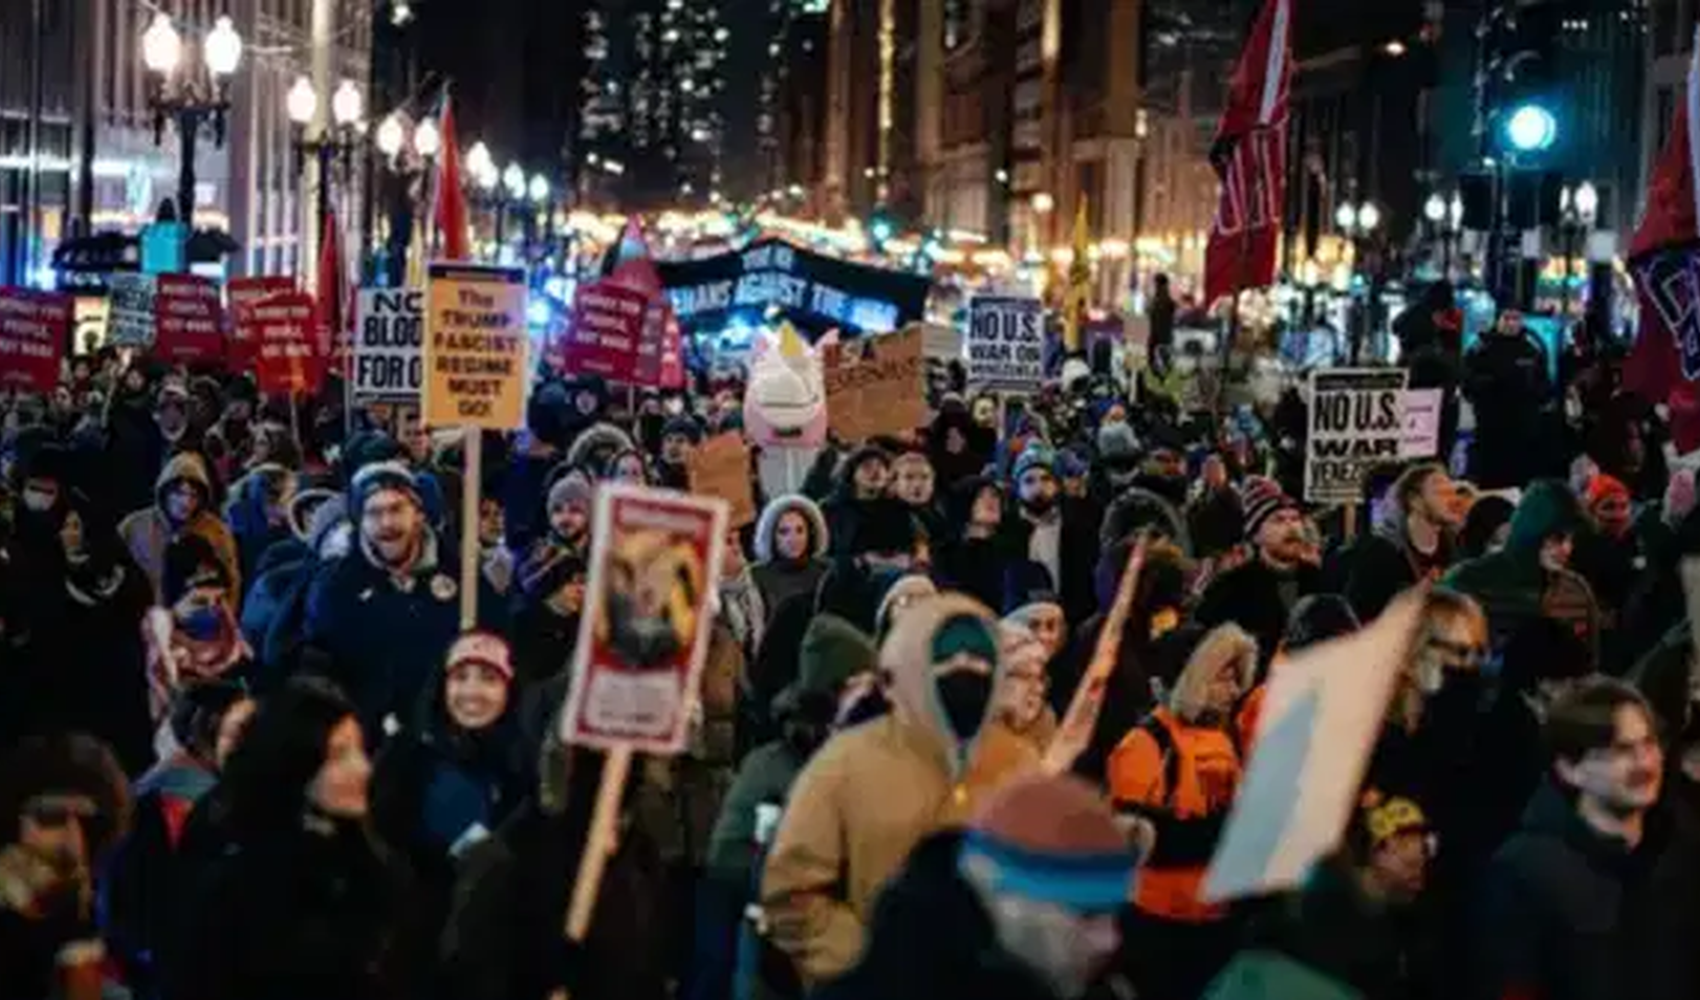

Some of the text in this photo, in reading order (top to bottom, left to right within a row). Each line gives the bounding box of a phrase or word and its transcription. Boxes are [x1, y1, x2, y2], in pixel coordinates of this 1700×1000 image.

[442, 308, 511, 329] TRUMP
[970, 310, 1041, 342] NO U.S.
[364, 316, 423, 347] BLOO
[434, 332, 518, 354] FASCIST
[970, 344, 1011, 361] WAR
[357, 355, 405, 388] FOR
[436, 355, 511, 376] REGIME
[447, 378, 503, 396] MUST
[1314, 391, 1400, 432] NO U.S.
[1312, 438, 1399, 458] WAR
[1310, 460, 1362, 488] VENEZ
